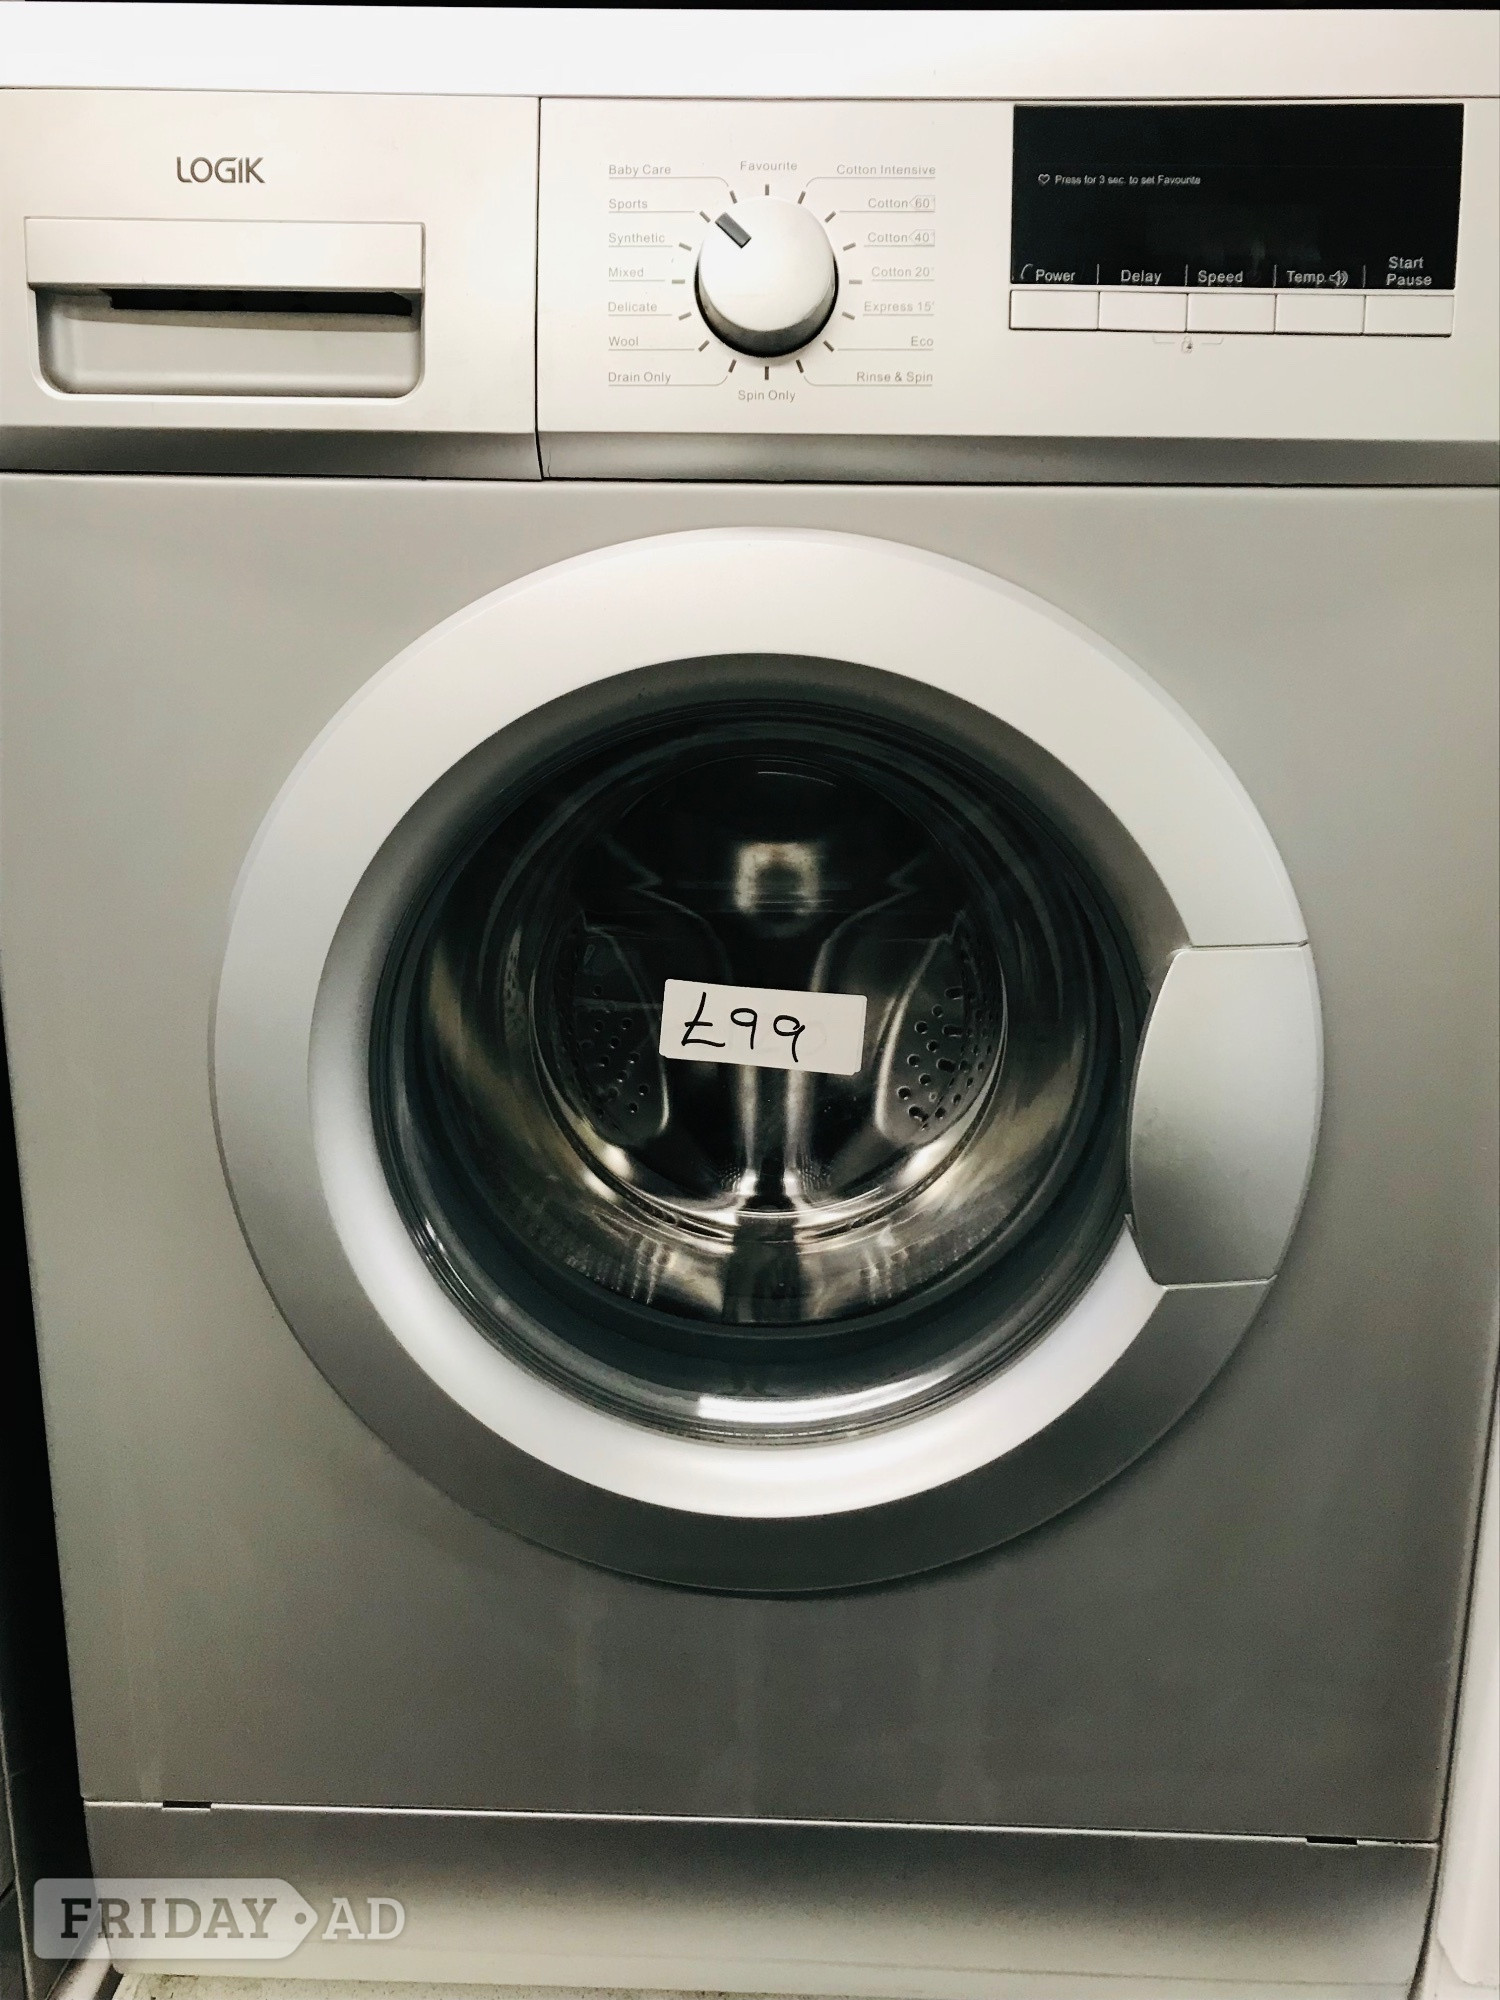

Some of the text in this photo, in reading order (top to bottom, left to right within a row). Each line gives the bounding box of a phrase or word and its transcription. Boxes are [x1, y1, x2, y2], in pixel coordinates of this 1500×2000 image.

[177, 156, 265, 183] LOGIK
[608, 164, 671, 177] Baby Care
[740, 161, 797, 171] Favourite
[836, 164, 936, 175] Cotton Intensive
[1055, 175, 1081, 184] Press
[1084, 175, 1096, 184] for
[1099, 175, 1105, 184] 3
[1129, 175, 1138, 184] to
[1141, 175, 1155, 184] set
[1157, 175, 1200, 185] Favourite
[608, 198, 648, 212] Sports
[868, 198, 908, 208] Cotton
[608, 232, 665, 245] Synthetic
[867, 232, 908, 243] Cotton
[1388, 256, 1424, 269] Start
[608, 267, 644, 277] Mixed
[871, 266, 912, 277] Cotton
[1035, 269, 1075, 282] Power
[1121, 269, 1162, 284] Delay
[1198, 270, 1243, 286] Speed
[1386, 273, 1432, 286] Pause
[608, 302, 657, 312] Delicate
[864, 302, 913, 313] Express
[608, 336, 639, 346] Wool
[911, 336, 934, 346] Eco
[608, 371, 671, 384] Drain Only
[856, 371, 933, 384] Rinse & Spin
[738, 390, 796, 403] Spin Only
[681, 991, 806, 1063] £99
